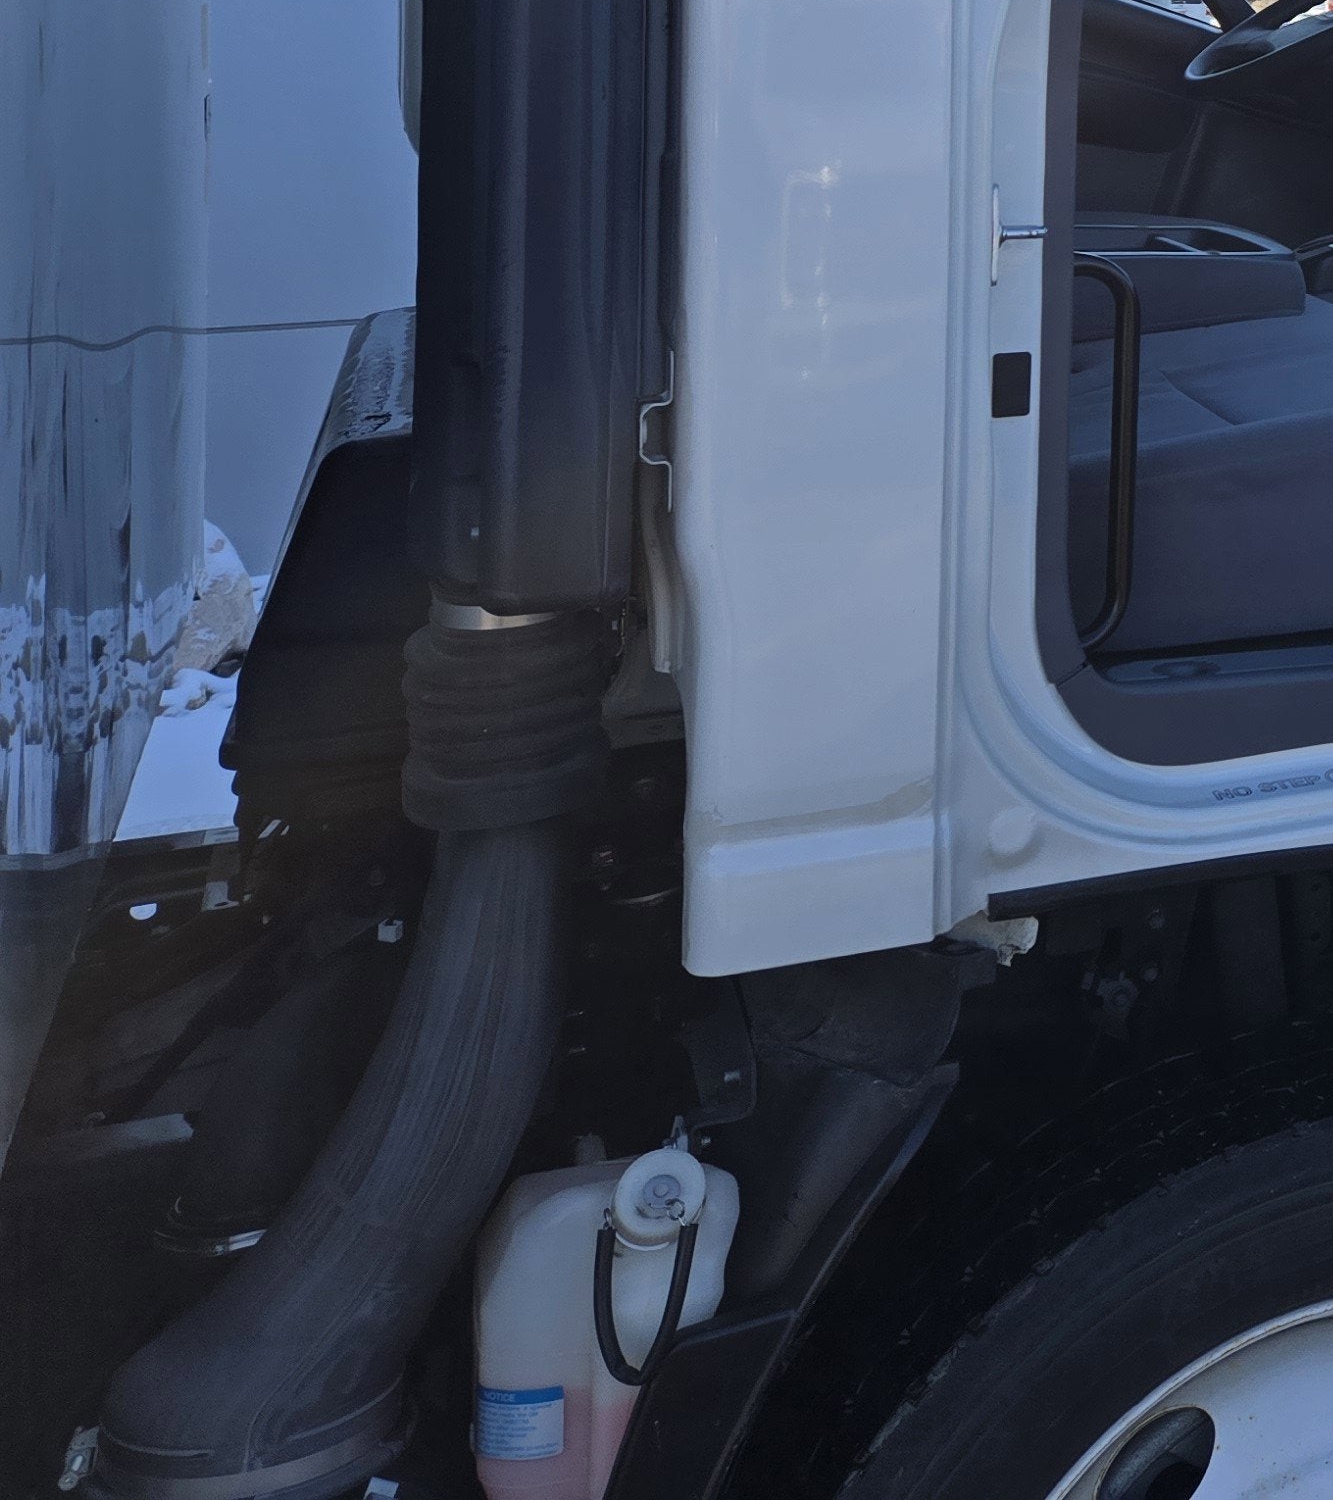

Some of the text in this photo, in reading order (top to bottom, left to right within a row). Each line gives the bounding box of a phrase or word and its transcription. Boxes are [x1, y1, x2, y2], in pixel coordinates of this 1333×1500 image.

[1212, 775, 1321, 801] NO STEP
[484, 1392, 516, 1403] NOTICE
